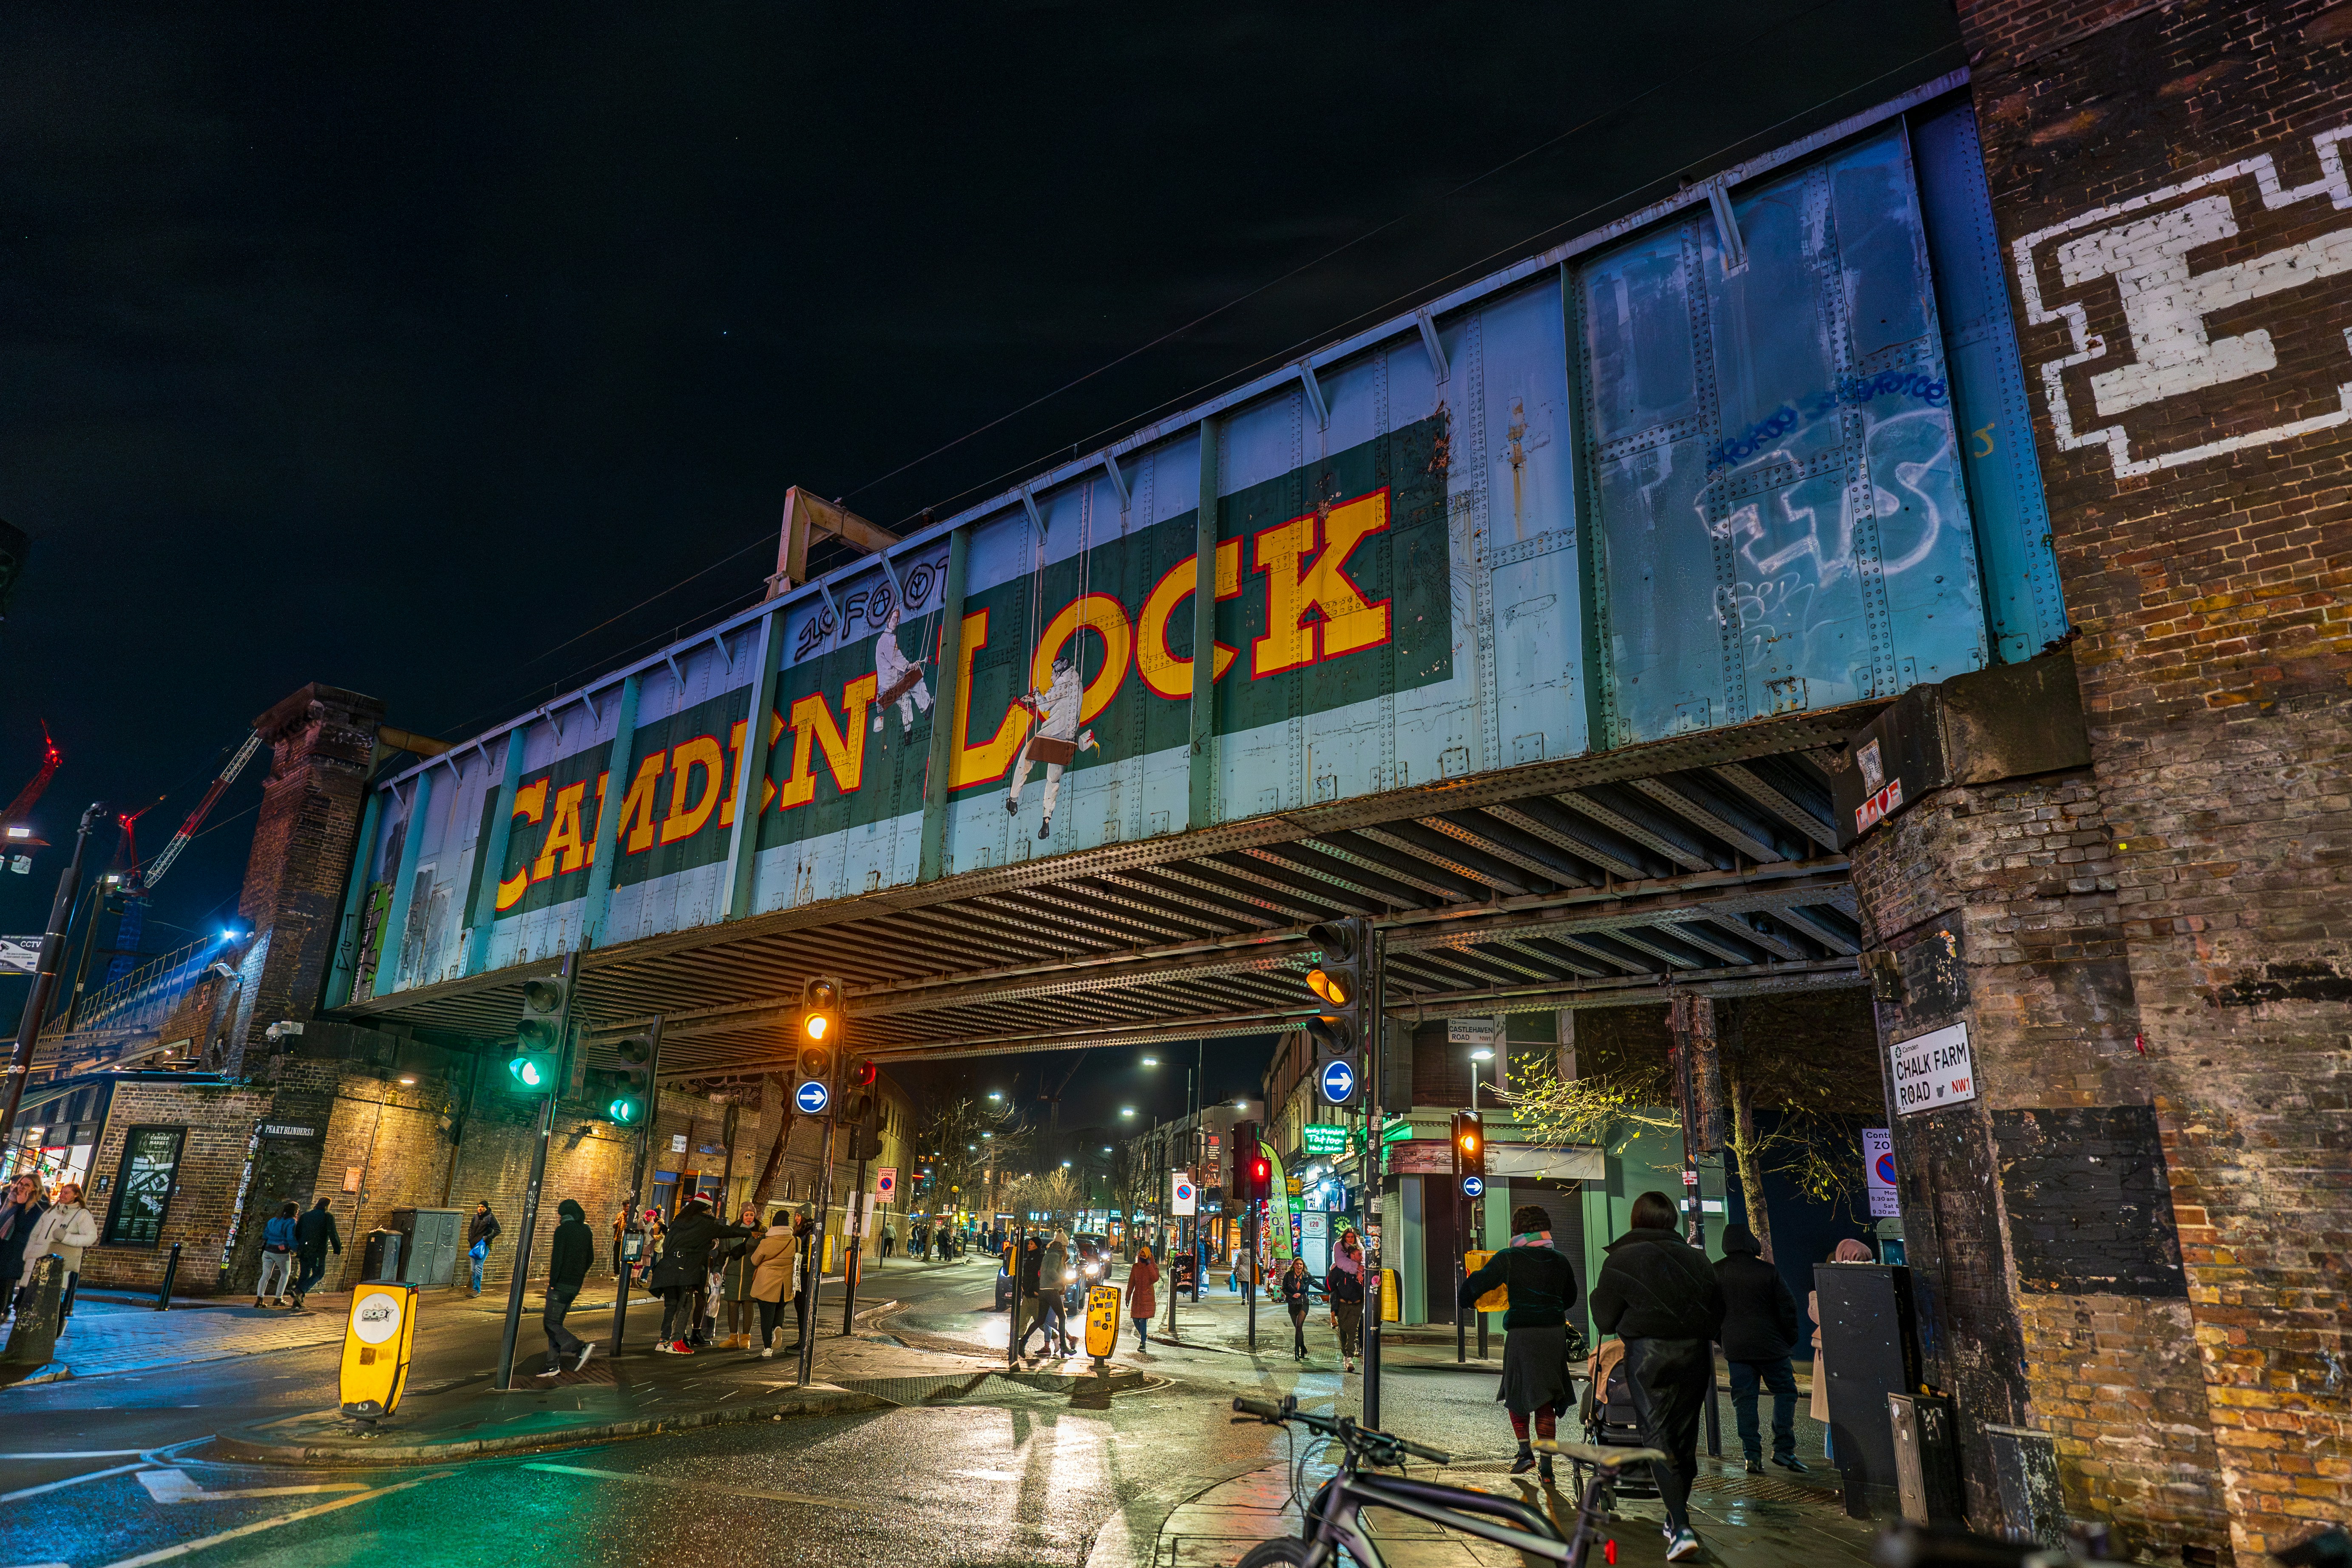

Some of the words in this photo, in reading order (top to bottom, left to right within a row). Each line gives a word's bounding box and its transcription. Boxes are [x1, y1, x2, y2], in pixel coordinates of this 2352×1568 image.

[496, 670, 877, 911] CAMDEN
[923, 486, 1391, 793] LOCK
[1902, 1044, 1919, 1053] Camden
[1897, 1053, 1932, 1080] CHALK
[1934, 1042, 1967, 1071] FARM
[1900, 1081, 1930, 1106] ROAD
[1952, 1077, 1970, 1094] NW1
[265, 1125, 284, 1134] PEAKY
[283, 1126, 311, 1136] BLINDERS
[1307, 1134, 1343, 1144] Tattoo
